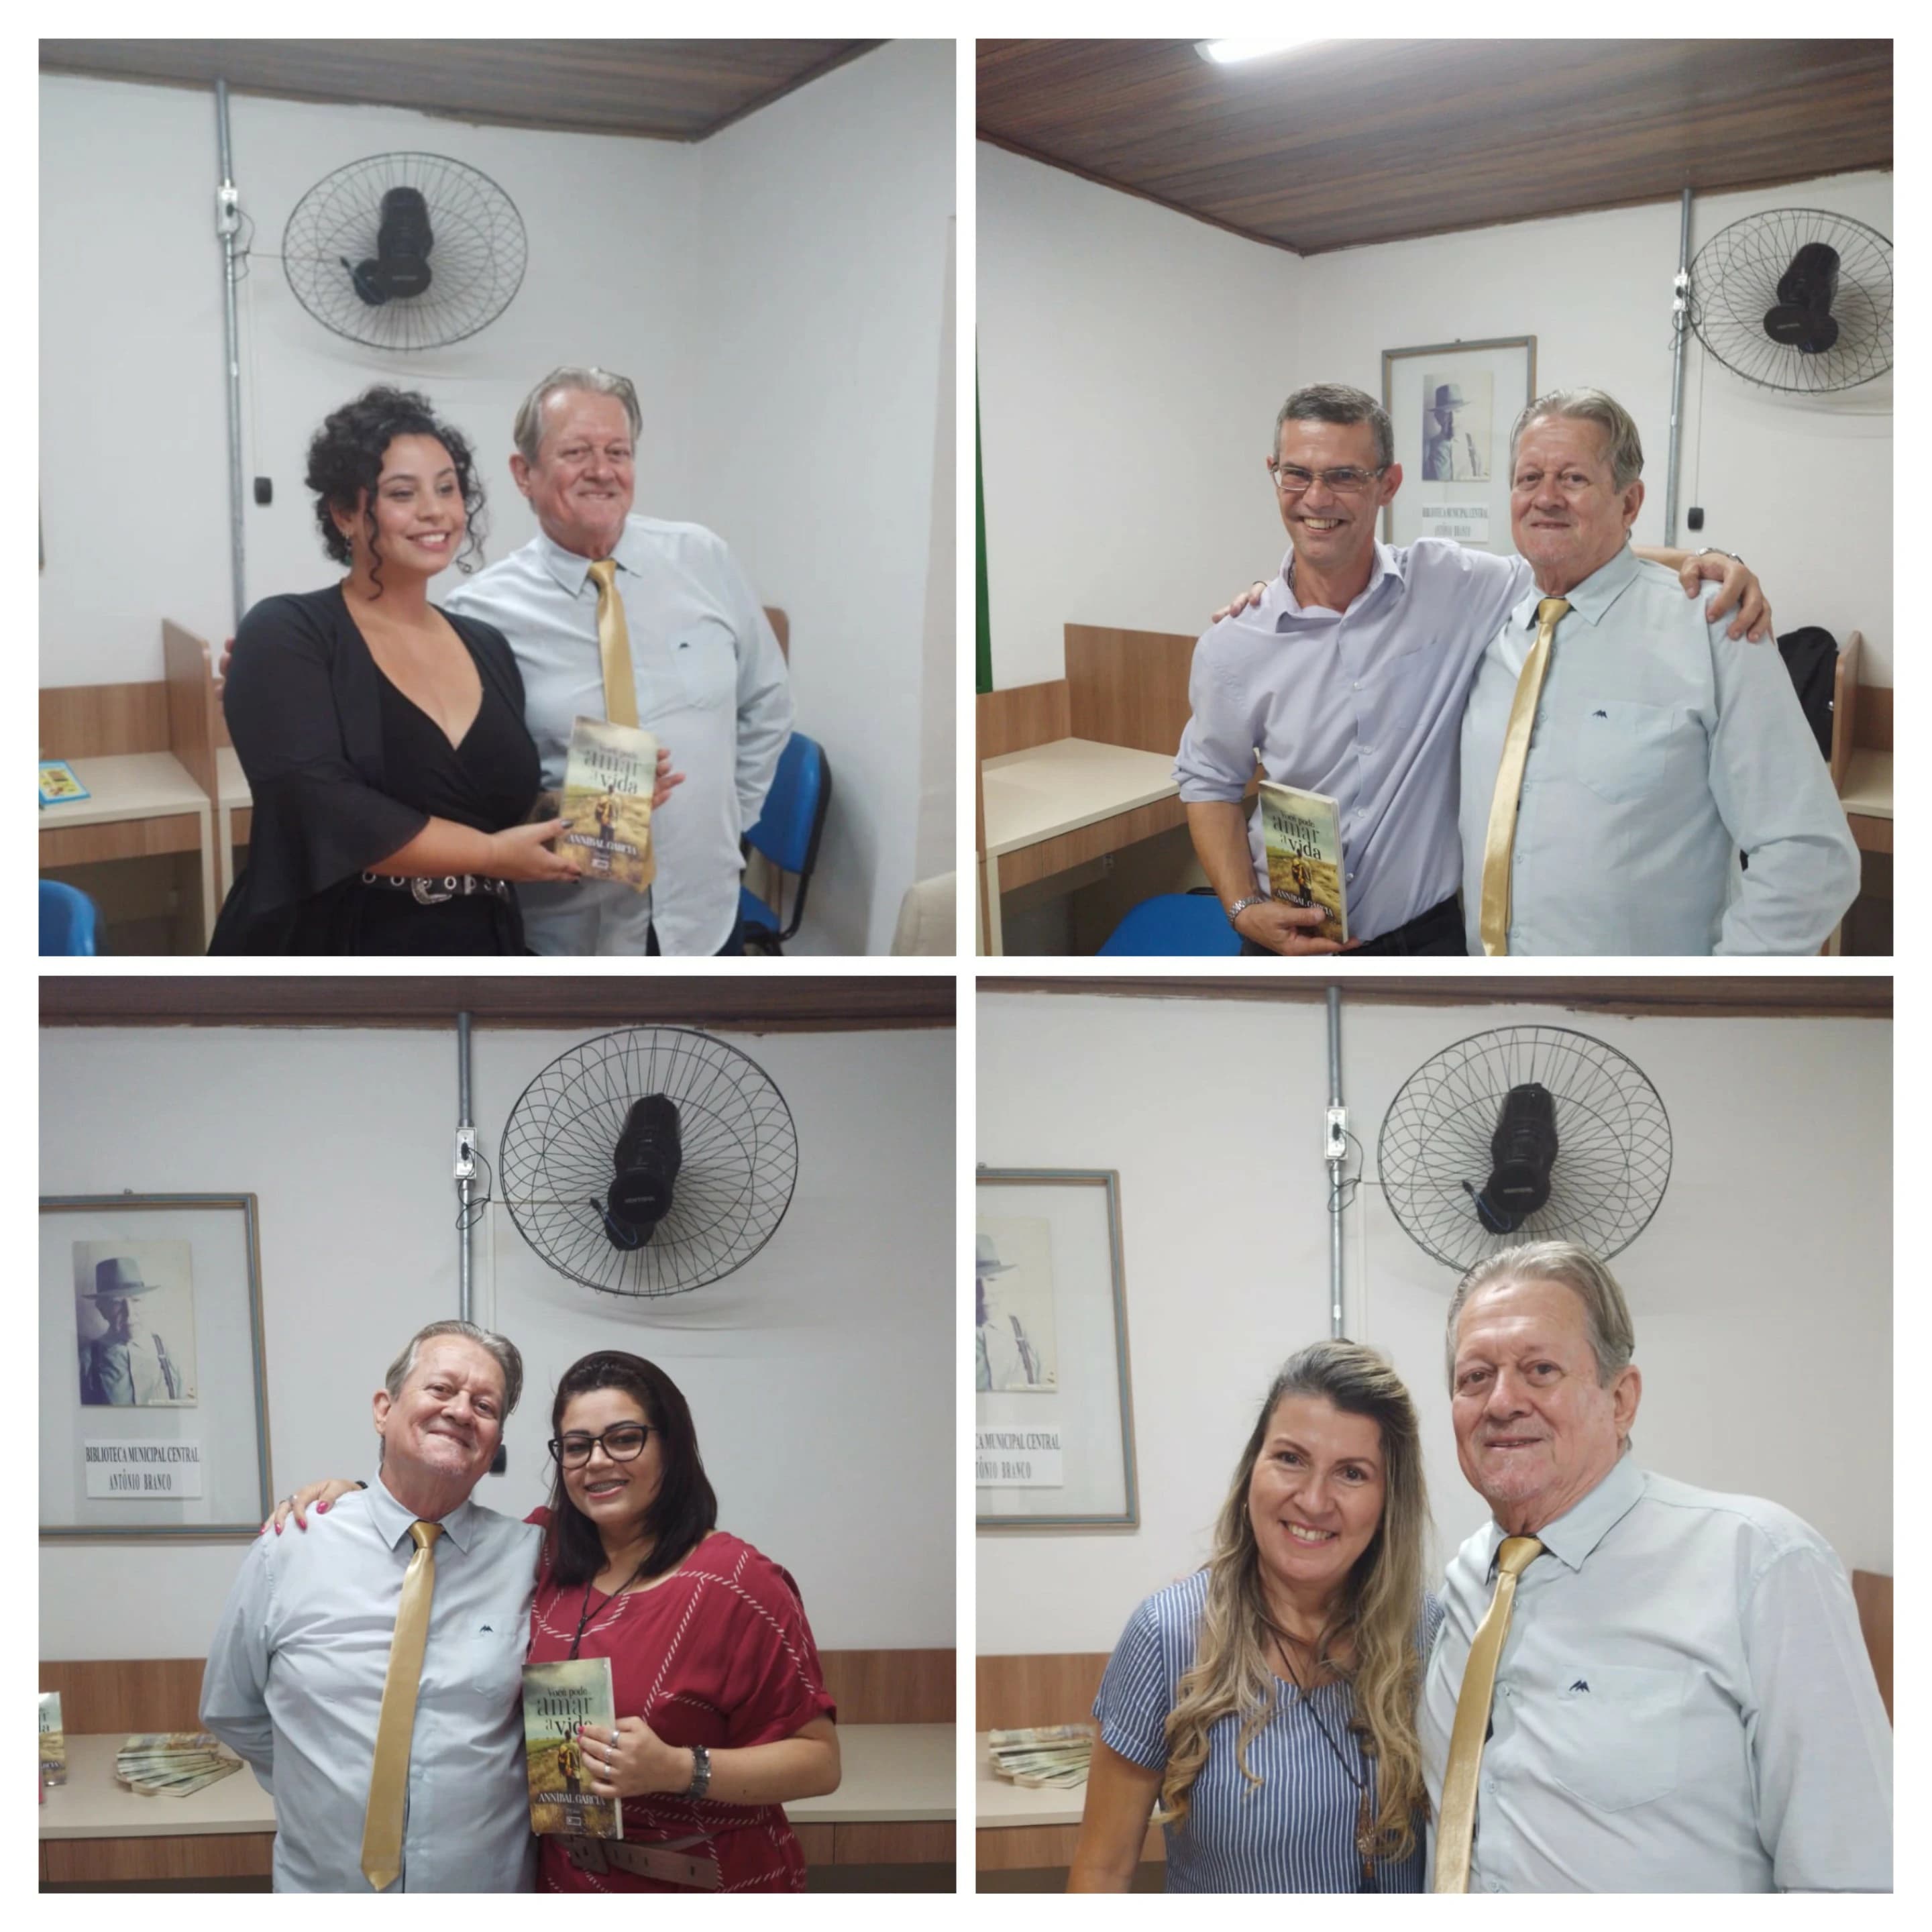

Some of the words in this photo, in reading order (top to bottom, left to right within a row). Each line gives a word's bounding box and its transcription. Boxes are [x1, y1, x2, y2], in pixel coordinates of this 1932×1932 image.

[1273, 815, 1320, 843] amar
[1288, 837, 1321, 861] vida
[86, 1446, 127, 1463] BIBLIOTECA
[128, 1446, 167, 1462] MUNICIPAL
[168, 1446, 199, 1462] CENTRAL
[144, 1474, 172, 1491] BRANCO
[537, 1697, 593, 1715] amar
[545, 1719, 553, 1730] a
[539, 1792, 575, 1804] ANNIBAL
[575, 1793, 606, 1805] GARCIA
